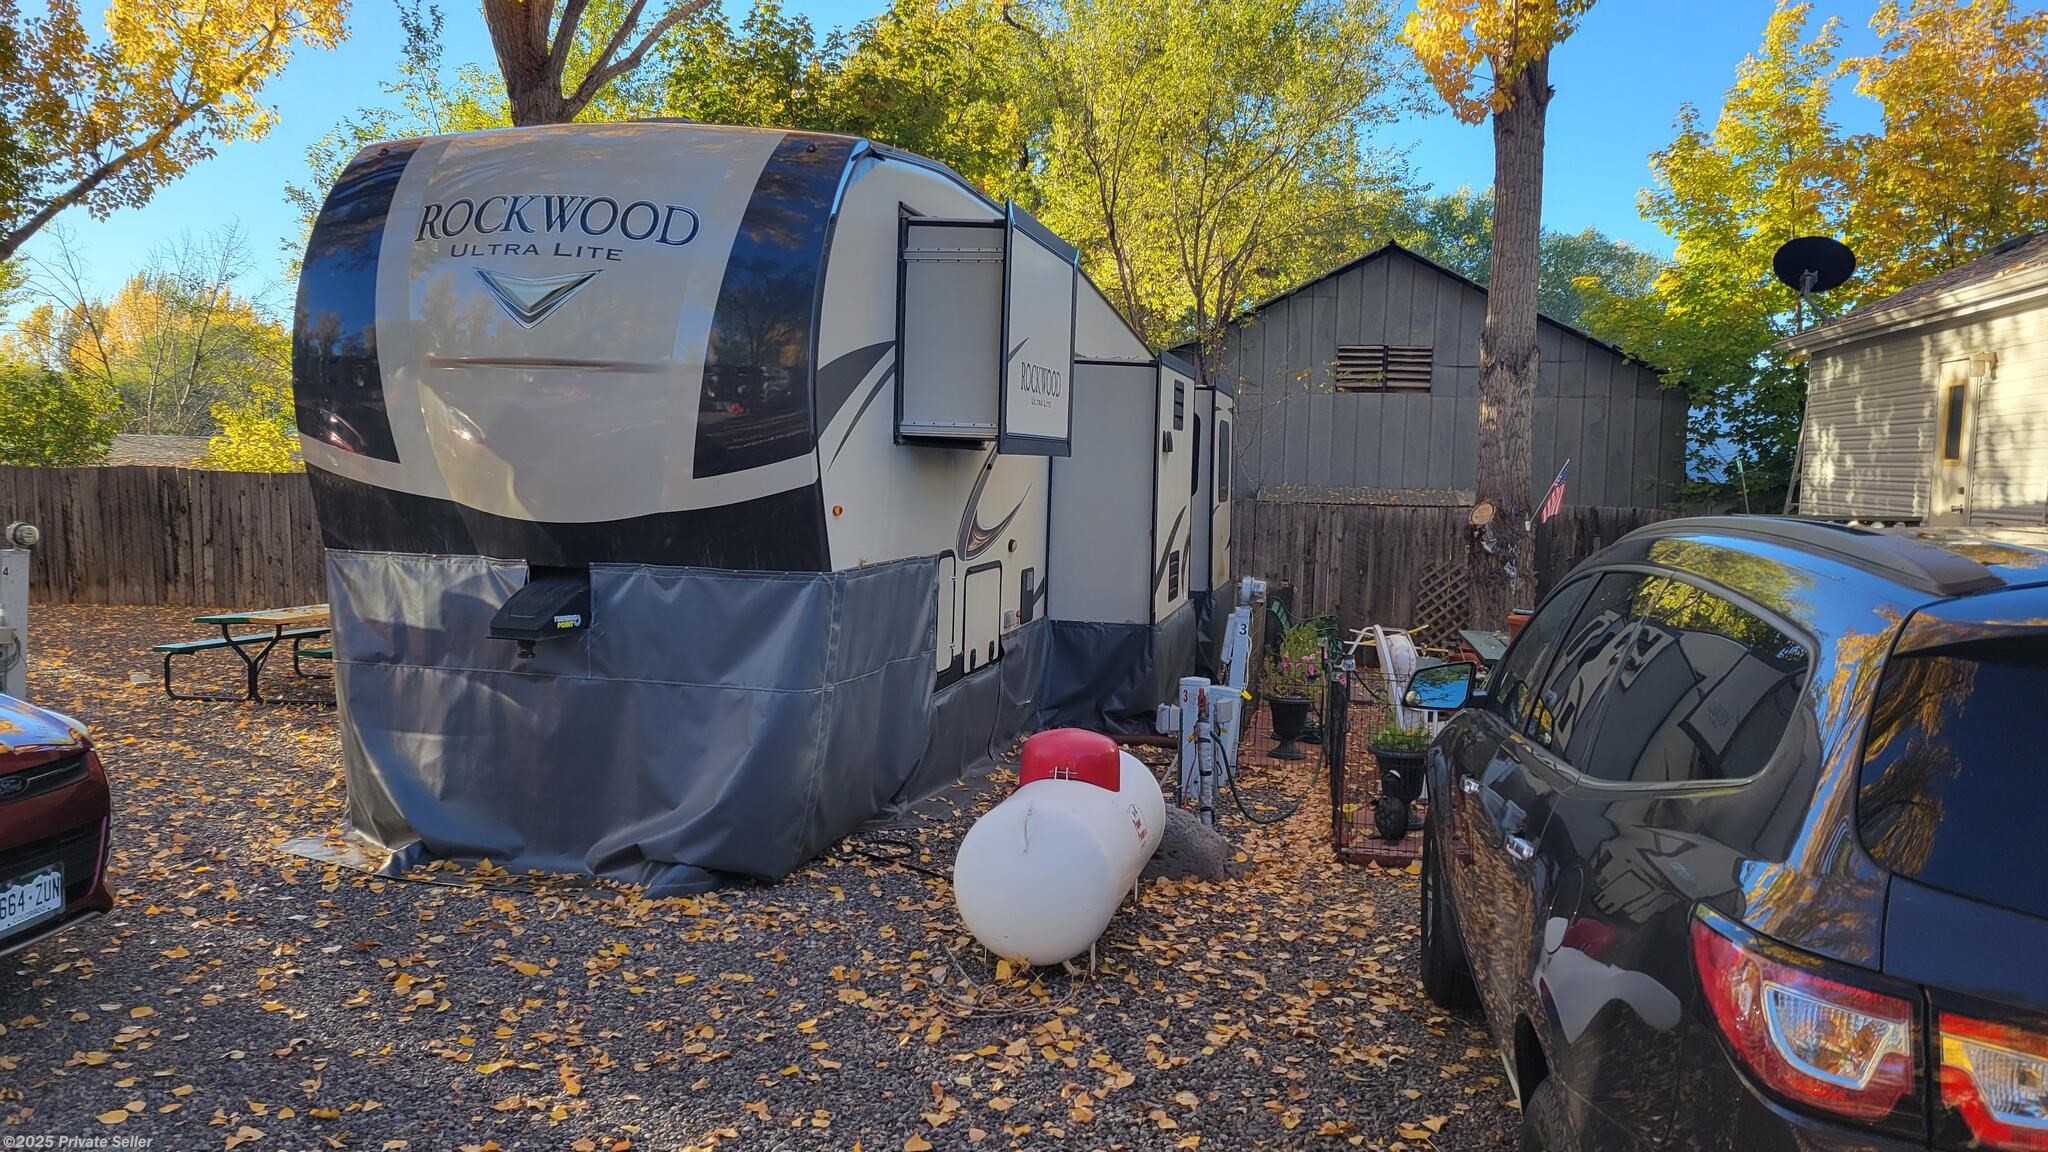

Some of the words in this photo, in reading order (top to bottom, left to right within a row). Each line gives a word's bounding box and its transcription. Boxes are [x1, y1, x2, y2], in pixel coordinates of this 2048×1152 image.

[414, 194, 700, 247] ROCKWOOD
[450, 243, 539, 258] ULTRA
[553, 243, 624, 262] LITE
[1020, 361, 1062, 398] ROCKWOOD
[2, 567, 9, 576] 4
[1239, 623, 1247, 635] 3
[1183, 689, 1189, 703] 3
